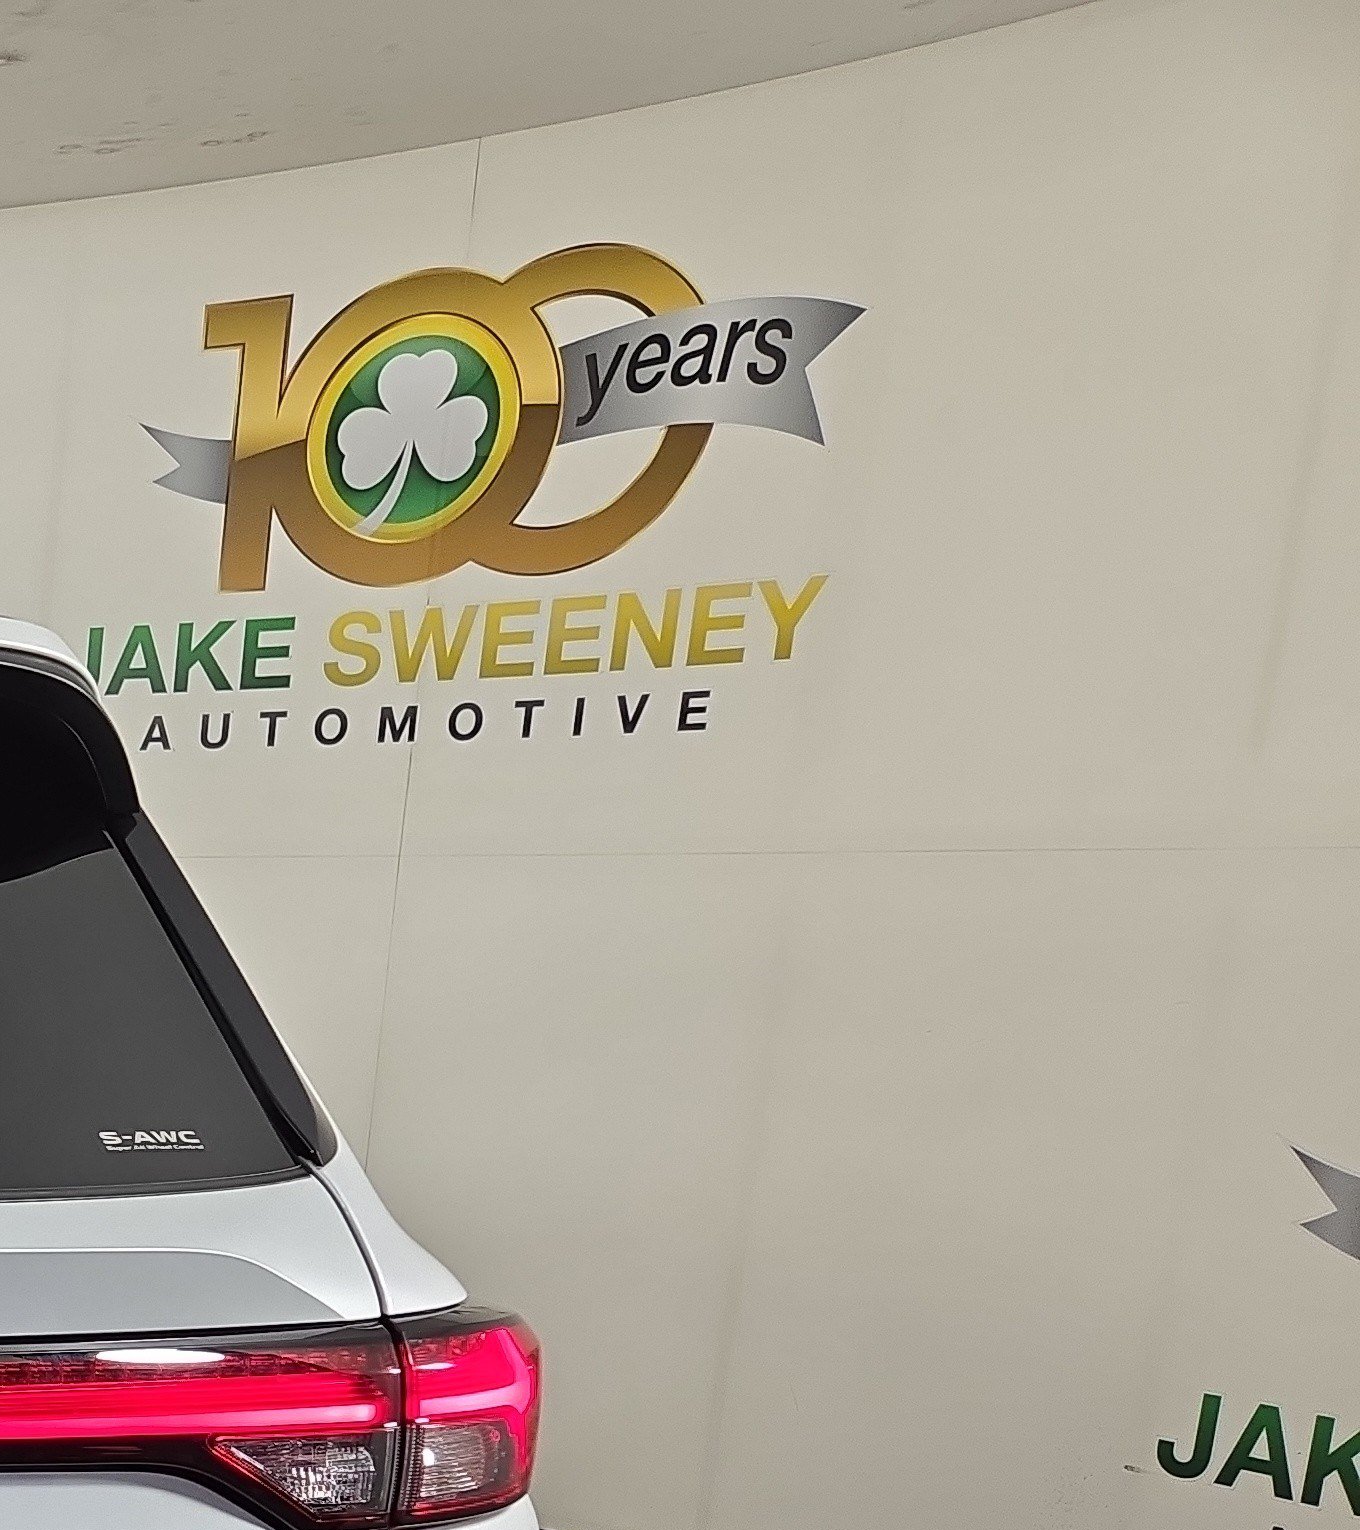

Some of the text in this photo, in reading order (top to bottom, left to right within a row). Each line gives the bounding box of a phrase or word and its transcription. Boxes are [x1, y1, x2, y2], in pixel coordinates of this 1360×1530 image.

[575, 308, 793, 426] years
[322, 575, 829, 687] SWEENEY
[139, 689, 712, 751] AUTOMOTIVE
[98, 1130, 201, 1144] S-AWC
[1157, 1393, 1360, 1516] JAK
